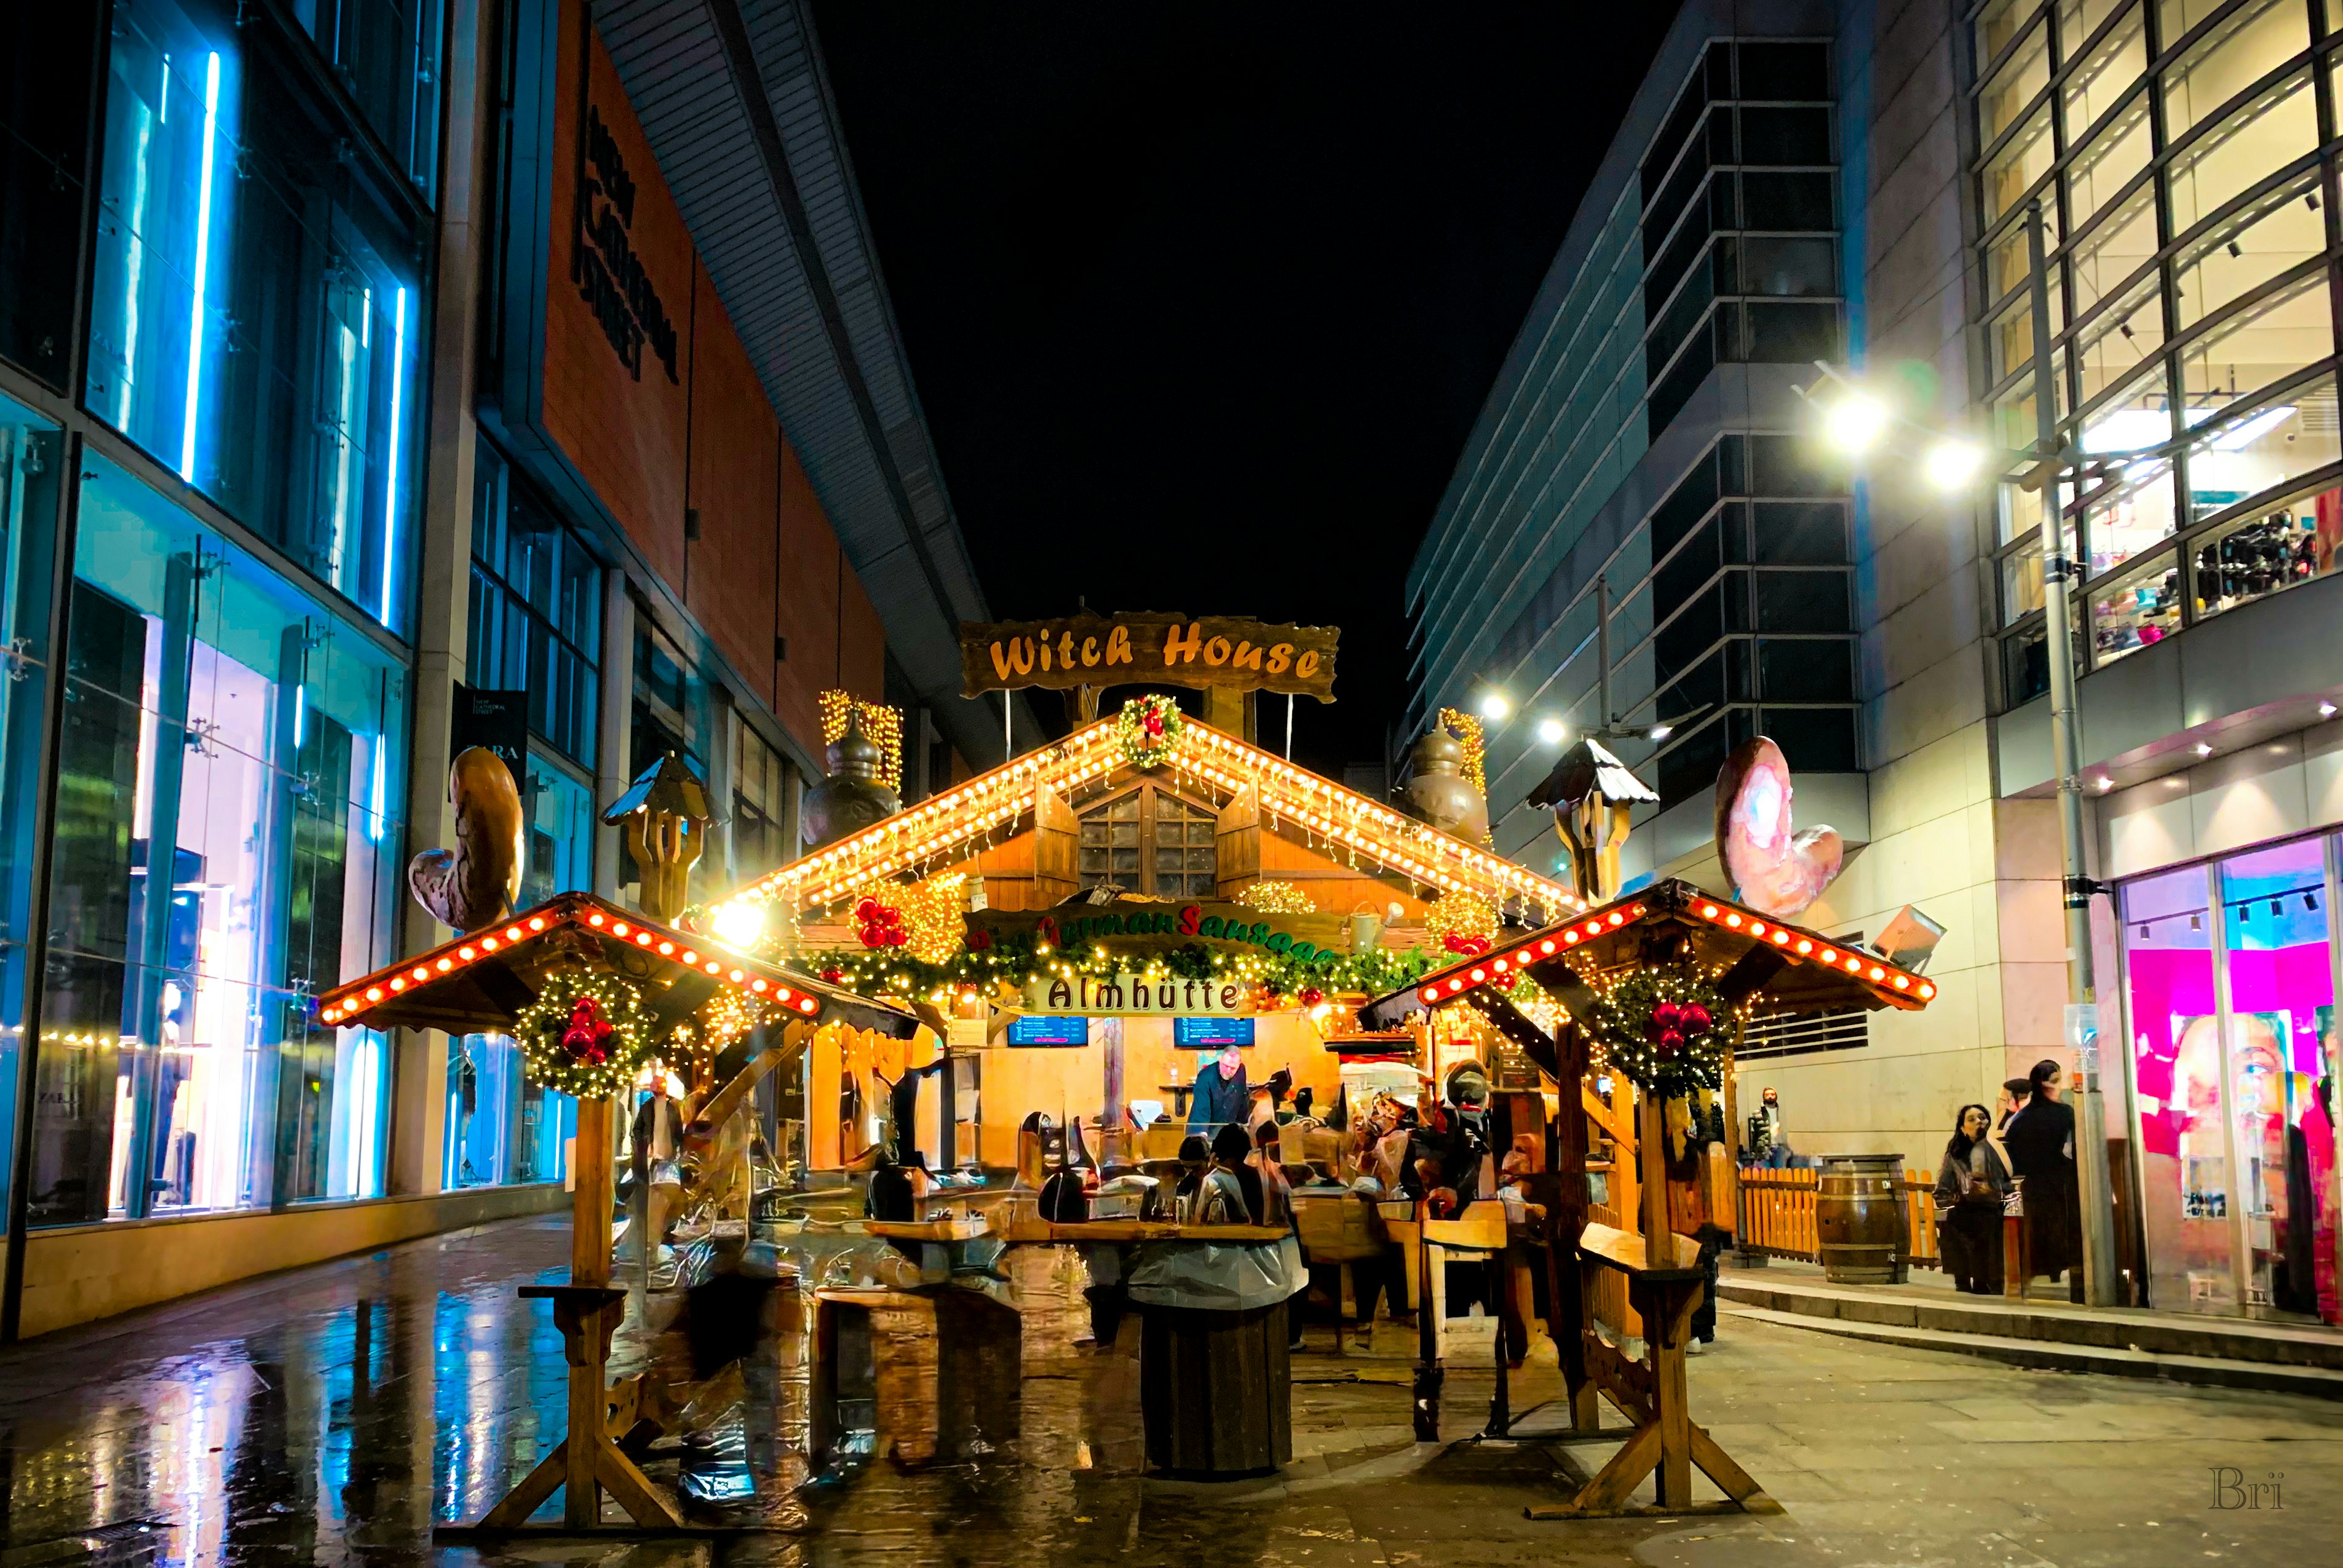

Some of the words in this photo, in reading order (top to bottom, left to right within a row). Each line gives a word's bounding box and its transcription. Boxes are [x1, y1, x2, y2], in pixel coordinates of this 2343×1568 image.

[990, 625, 1133, 681] Witch
[1163, 622, 1319, 678] House
[1037, 913, 1174, 949] German
[1048, 976, 1239, 1012] Almhütte
